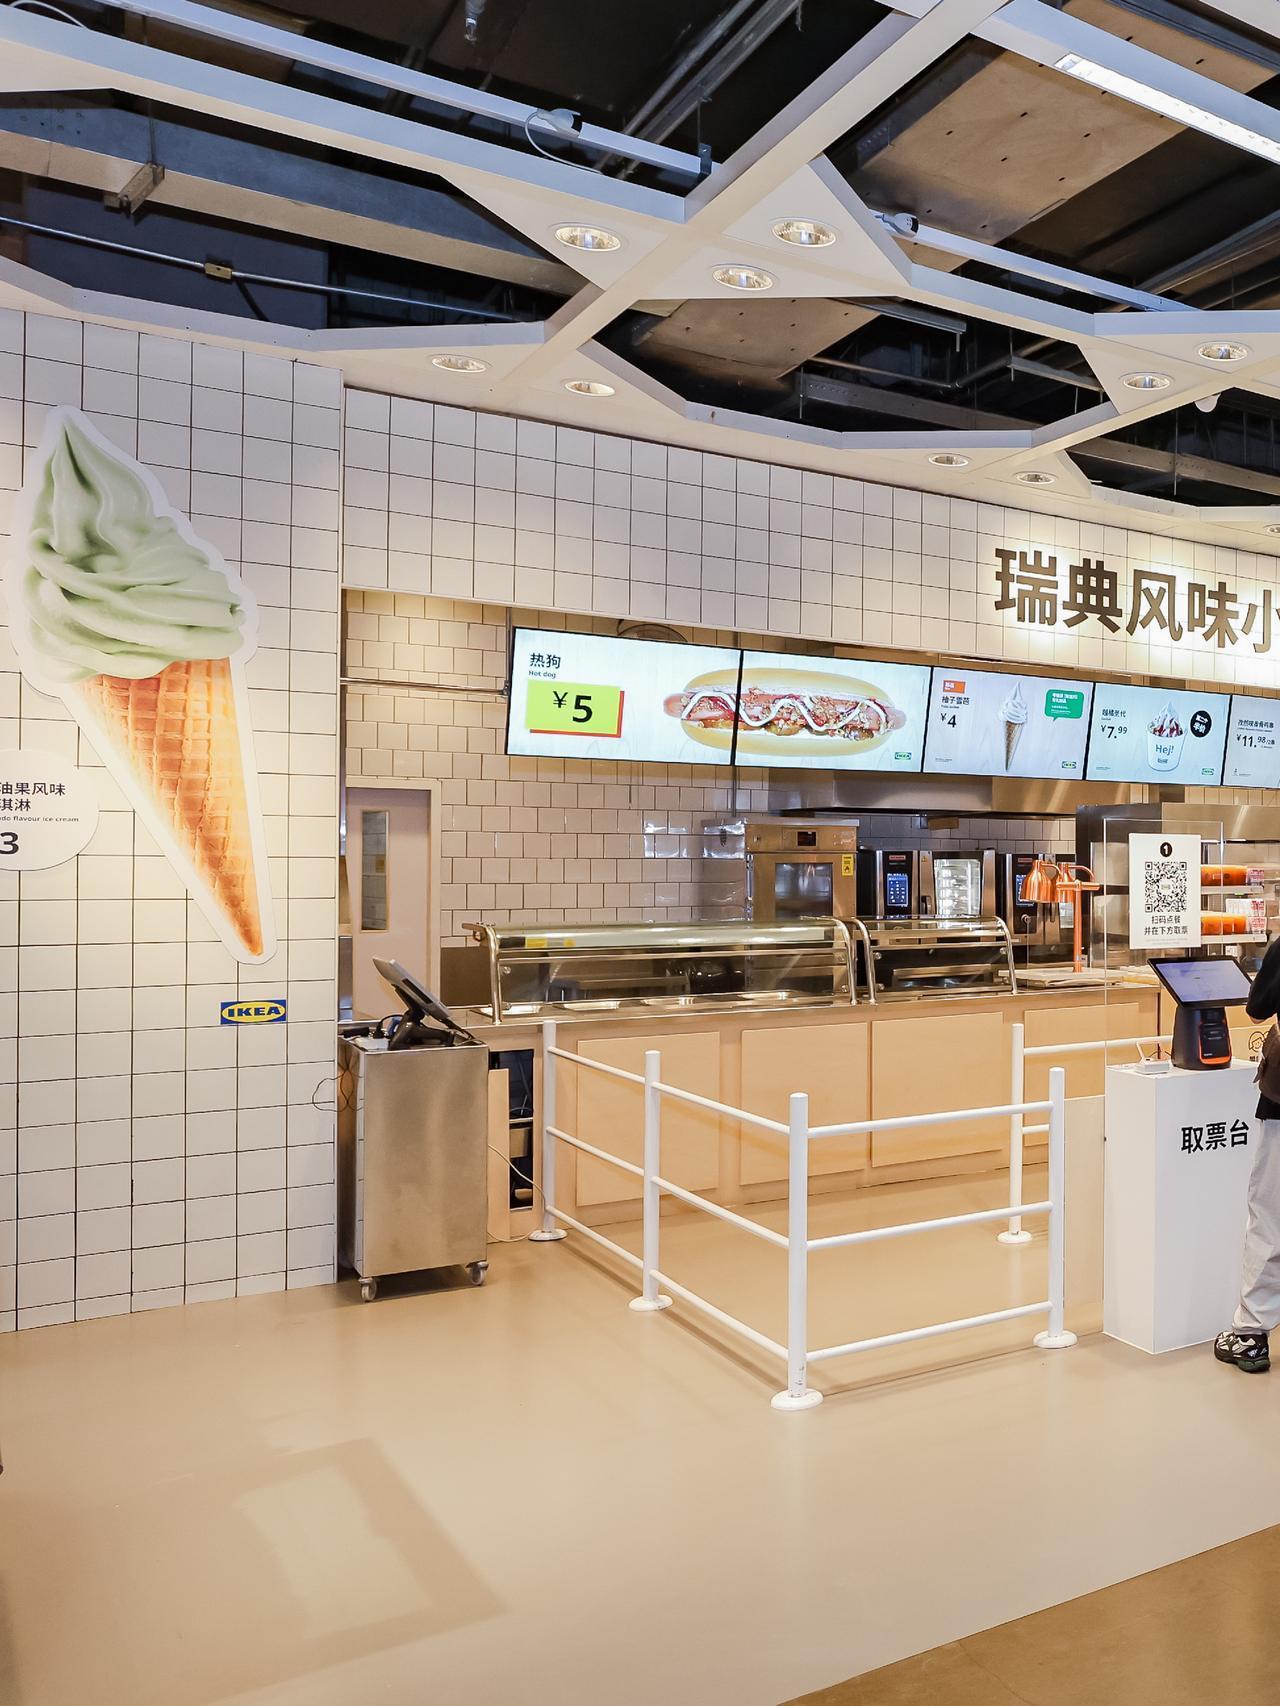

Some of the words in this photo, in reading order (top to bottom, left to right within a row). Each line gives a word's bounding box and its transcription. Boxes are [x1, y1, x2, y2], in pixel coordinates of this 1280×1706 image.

[530, 652, 561, 669] 热狗
[543, 671, 556, 679] dog
[1155, 744, 1174, 756] Hej!
[0, 832, 19, 855] 3
[1151, 915, 1181, 924] 扫码点餐
[1144, 926, 1188, 936] 并在下方取票
[228, 1005, 281, 1017] IKEA
[1181, 1119, 1250, 1154] 取票台
